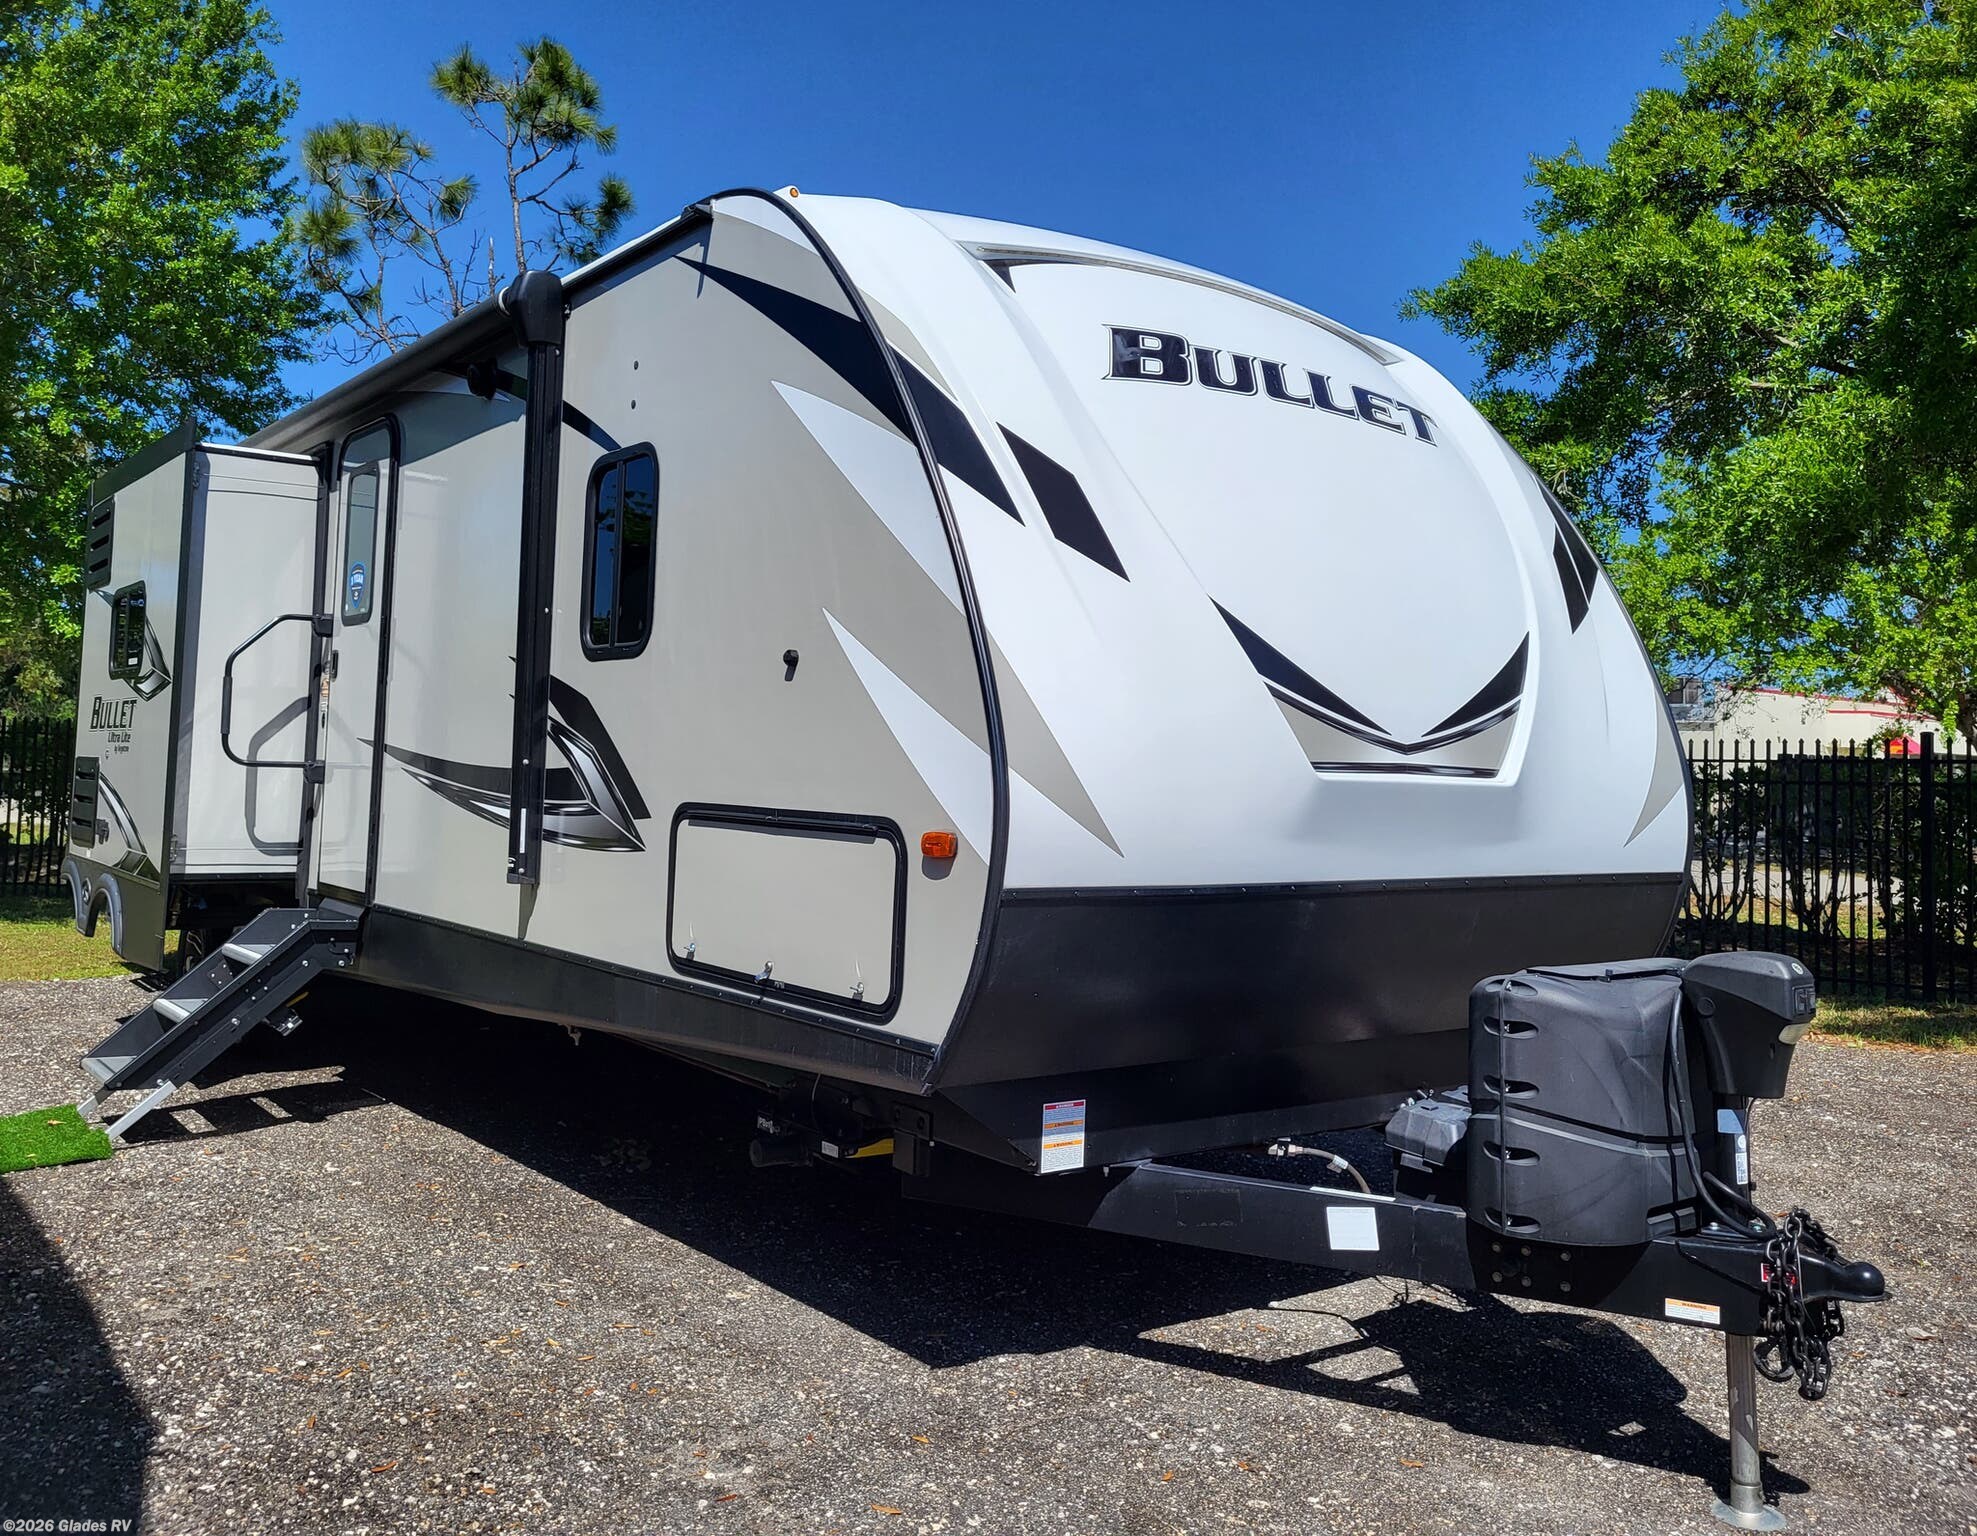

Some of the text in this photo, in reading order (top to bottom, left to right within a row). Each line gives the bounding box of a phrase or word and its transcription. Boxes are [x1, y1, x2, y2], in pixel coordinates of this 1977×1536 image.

[1101, 324, 1438, 447] BULLET
[90, 695, 138, 731] BULLET
[121, 731, 131, 743] Lite
